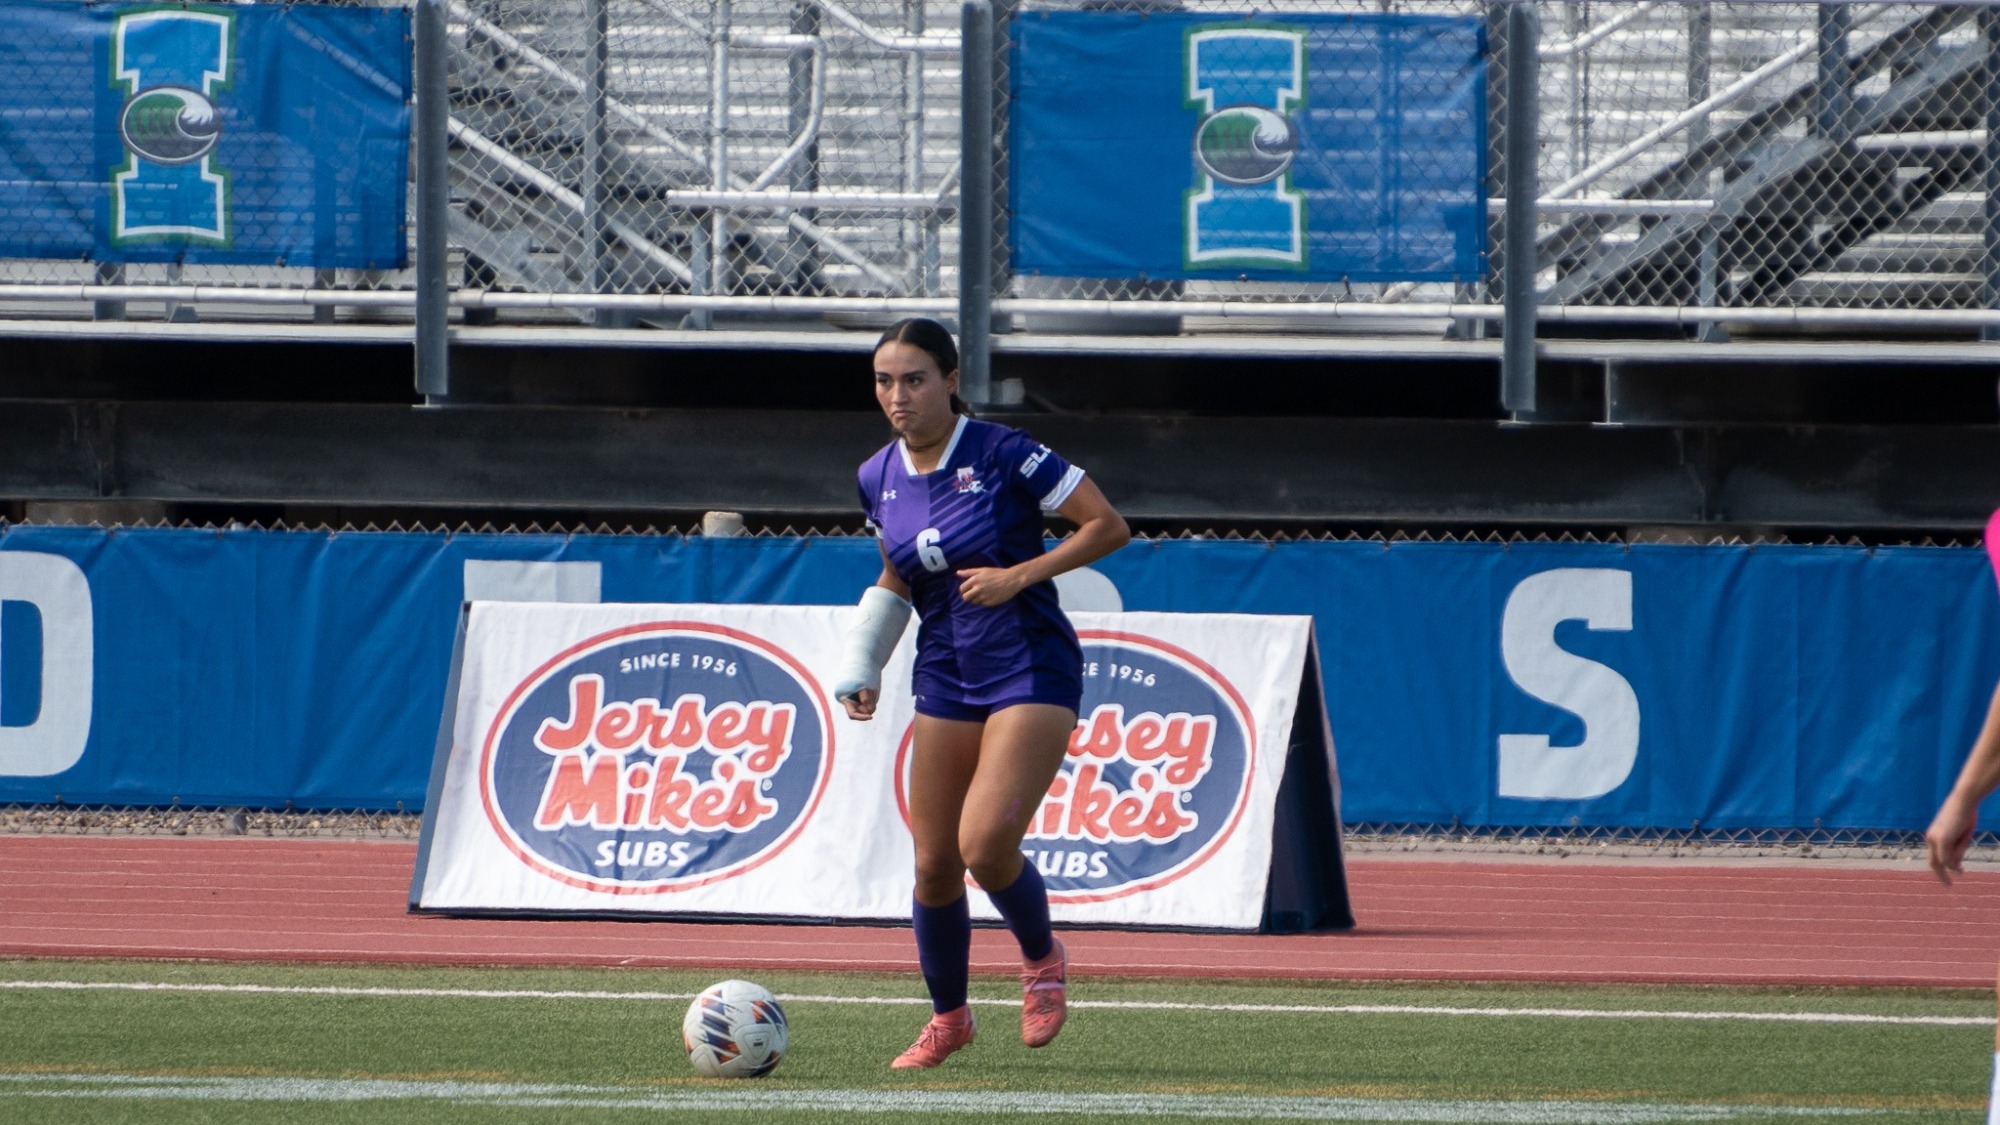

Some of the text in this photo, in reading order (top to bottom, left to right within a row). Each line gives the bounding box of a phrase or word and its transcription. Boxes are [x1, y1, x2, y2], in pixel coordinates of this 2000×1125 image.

[916, 528, 949, 572] 6
[620, 652, 738, 678] SINCE 1956
[1109, 663, 1157, 687] 1956
[536, 676, 794, 774] Jersey
[537, 754, 775, 831] Mike's
[1024, 761, 1195, 841] ike's
[594, 840, 690, 868] SUBS
